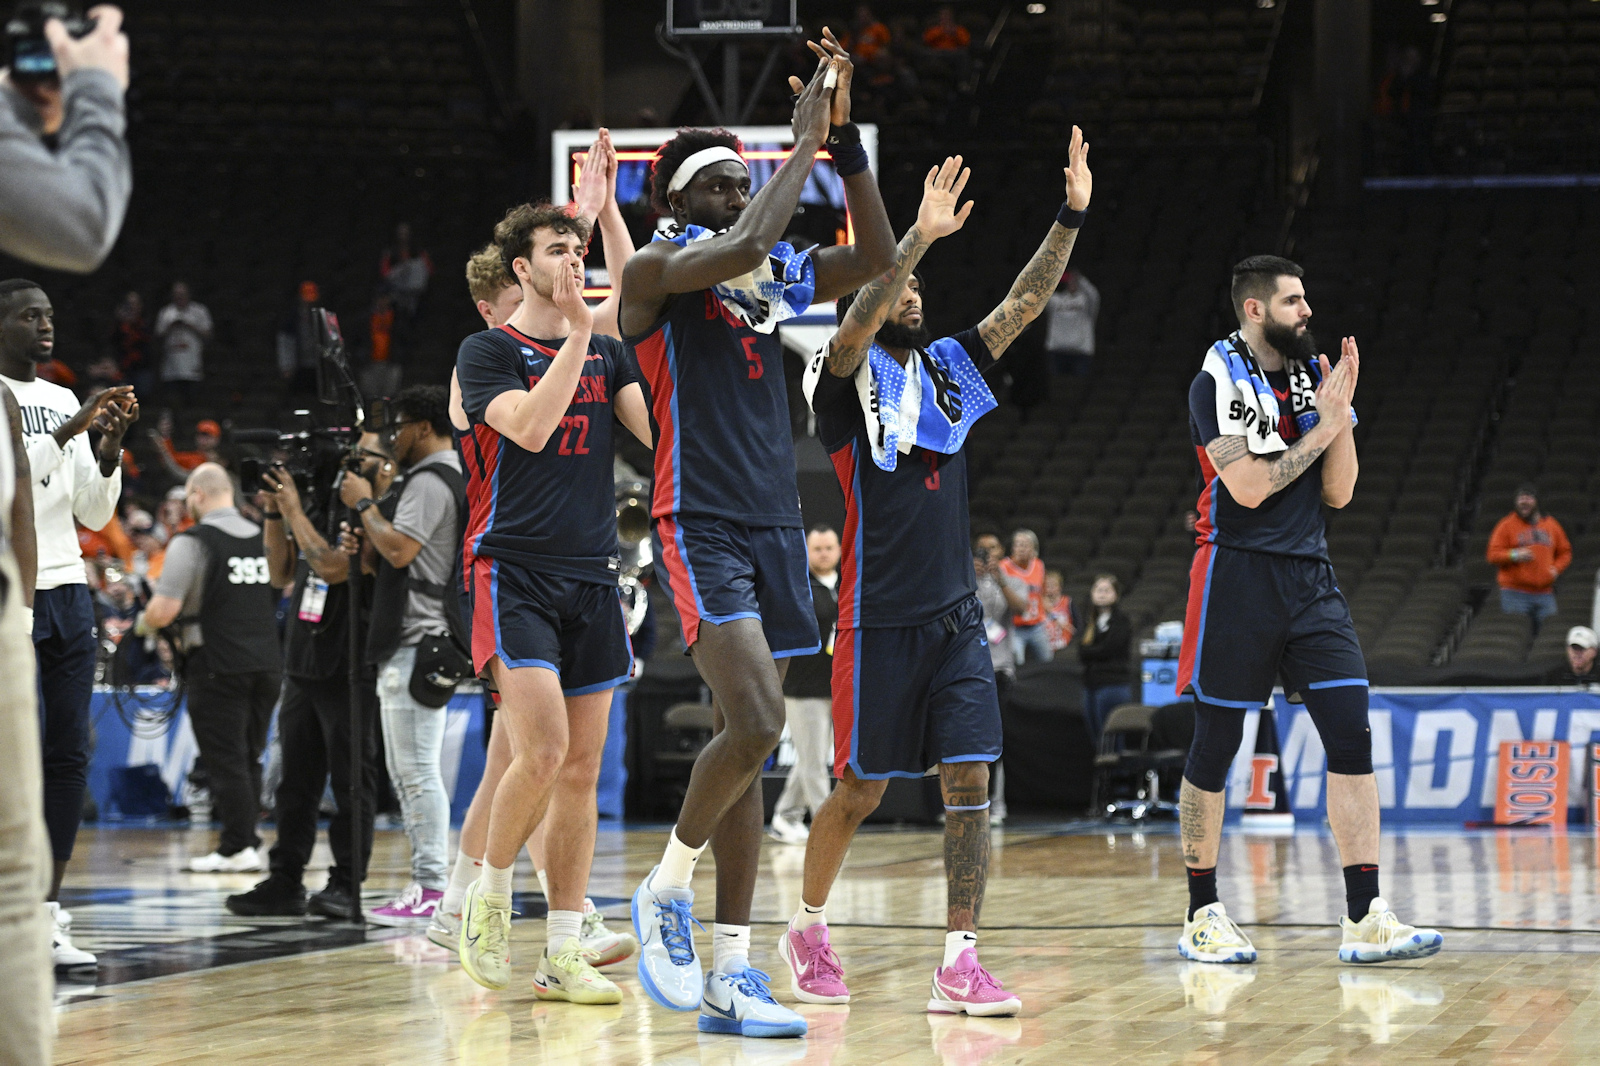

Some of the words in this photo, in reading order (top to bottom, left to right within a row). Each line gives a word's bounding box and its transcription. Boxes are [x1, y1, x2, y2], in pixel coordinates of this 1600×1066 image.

[741, 337, 764, 379] 5
[528, 374, 608, 405] DESNE
[557, 414, 590, 456] 22
[922, 451, 941, 491] 3
[227, 556, 270, 584] 393
[1506, 742, 1558, 826] NOISE
